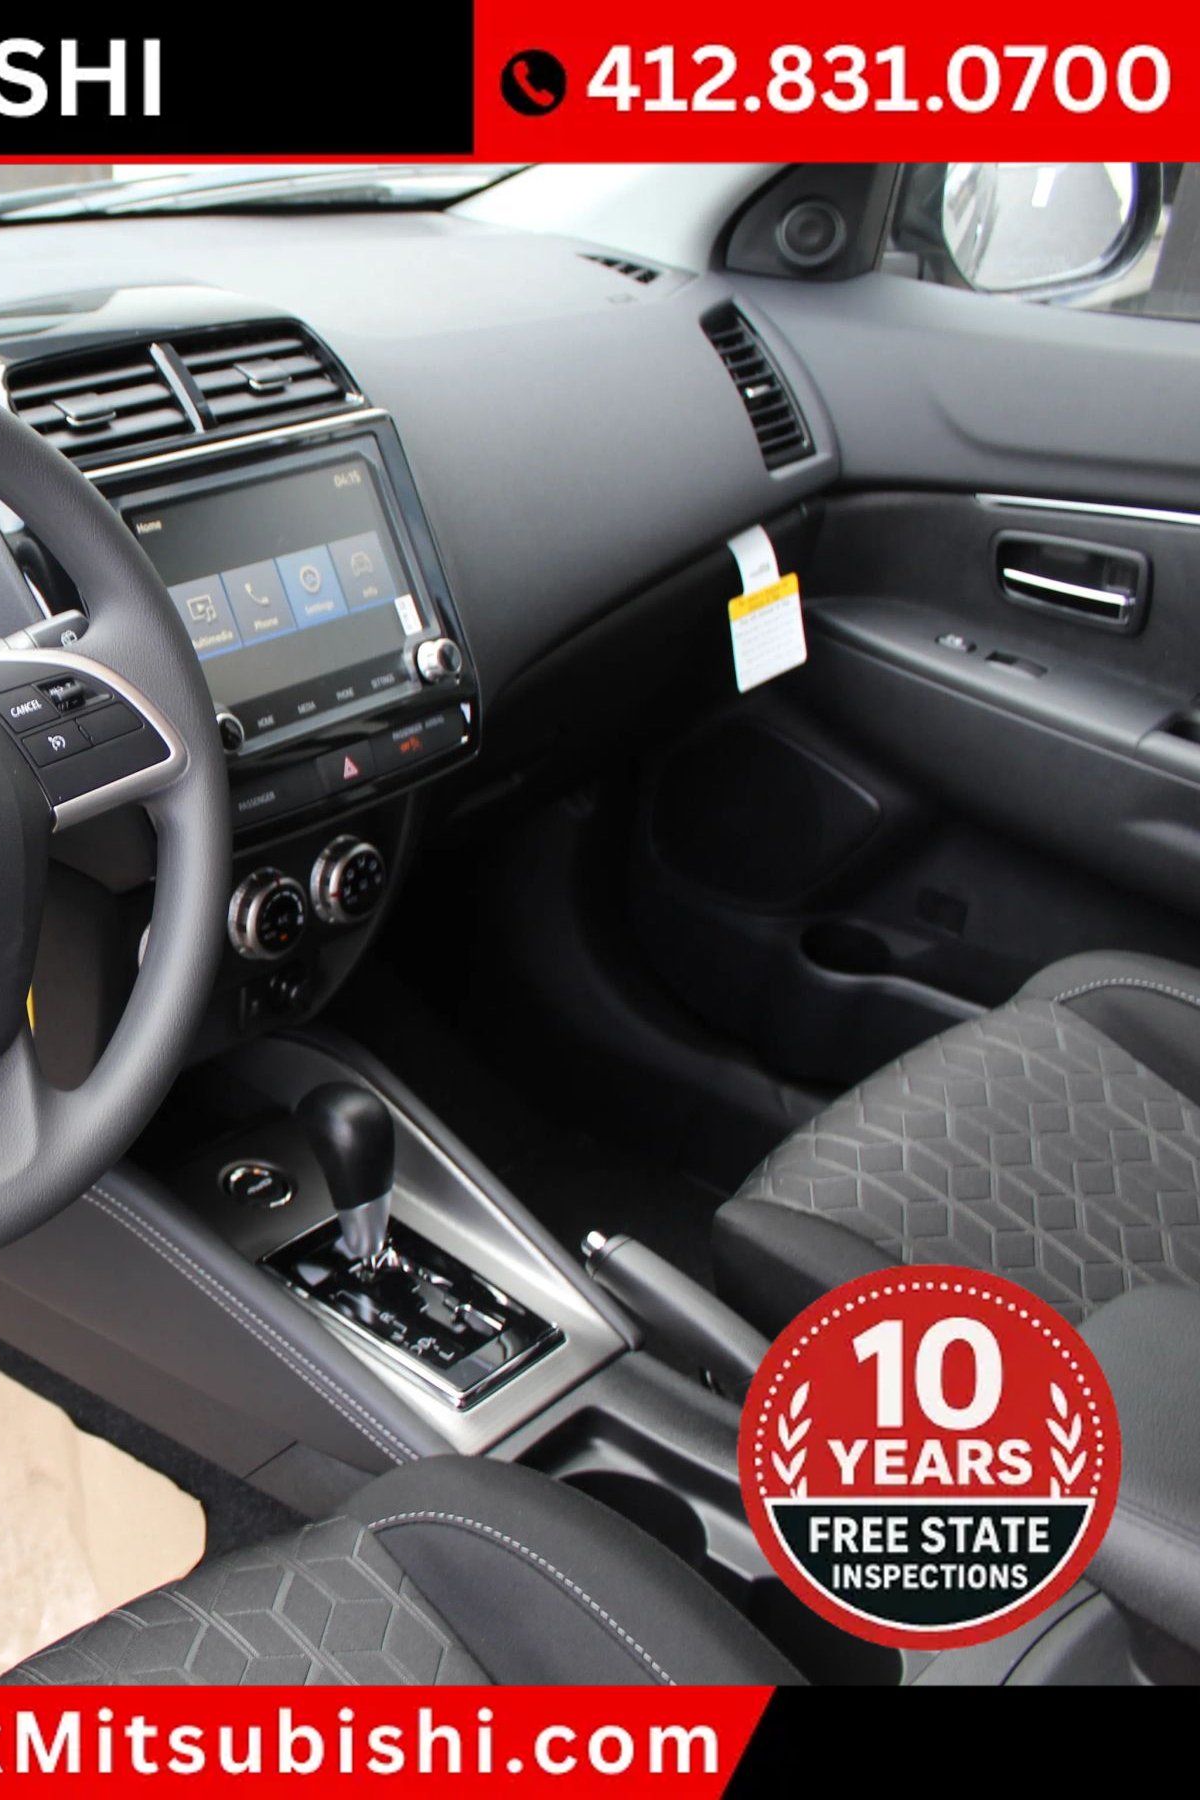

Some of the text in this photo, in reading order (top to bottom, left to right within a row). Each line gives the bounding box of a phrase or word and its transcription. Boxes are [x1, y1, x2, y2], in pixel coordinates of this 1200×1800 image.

[137, 520, 162, 534] Home
[254, 616, 278, 631] Phone
[10, 699, 43, 718] CANCEL
